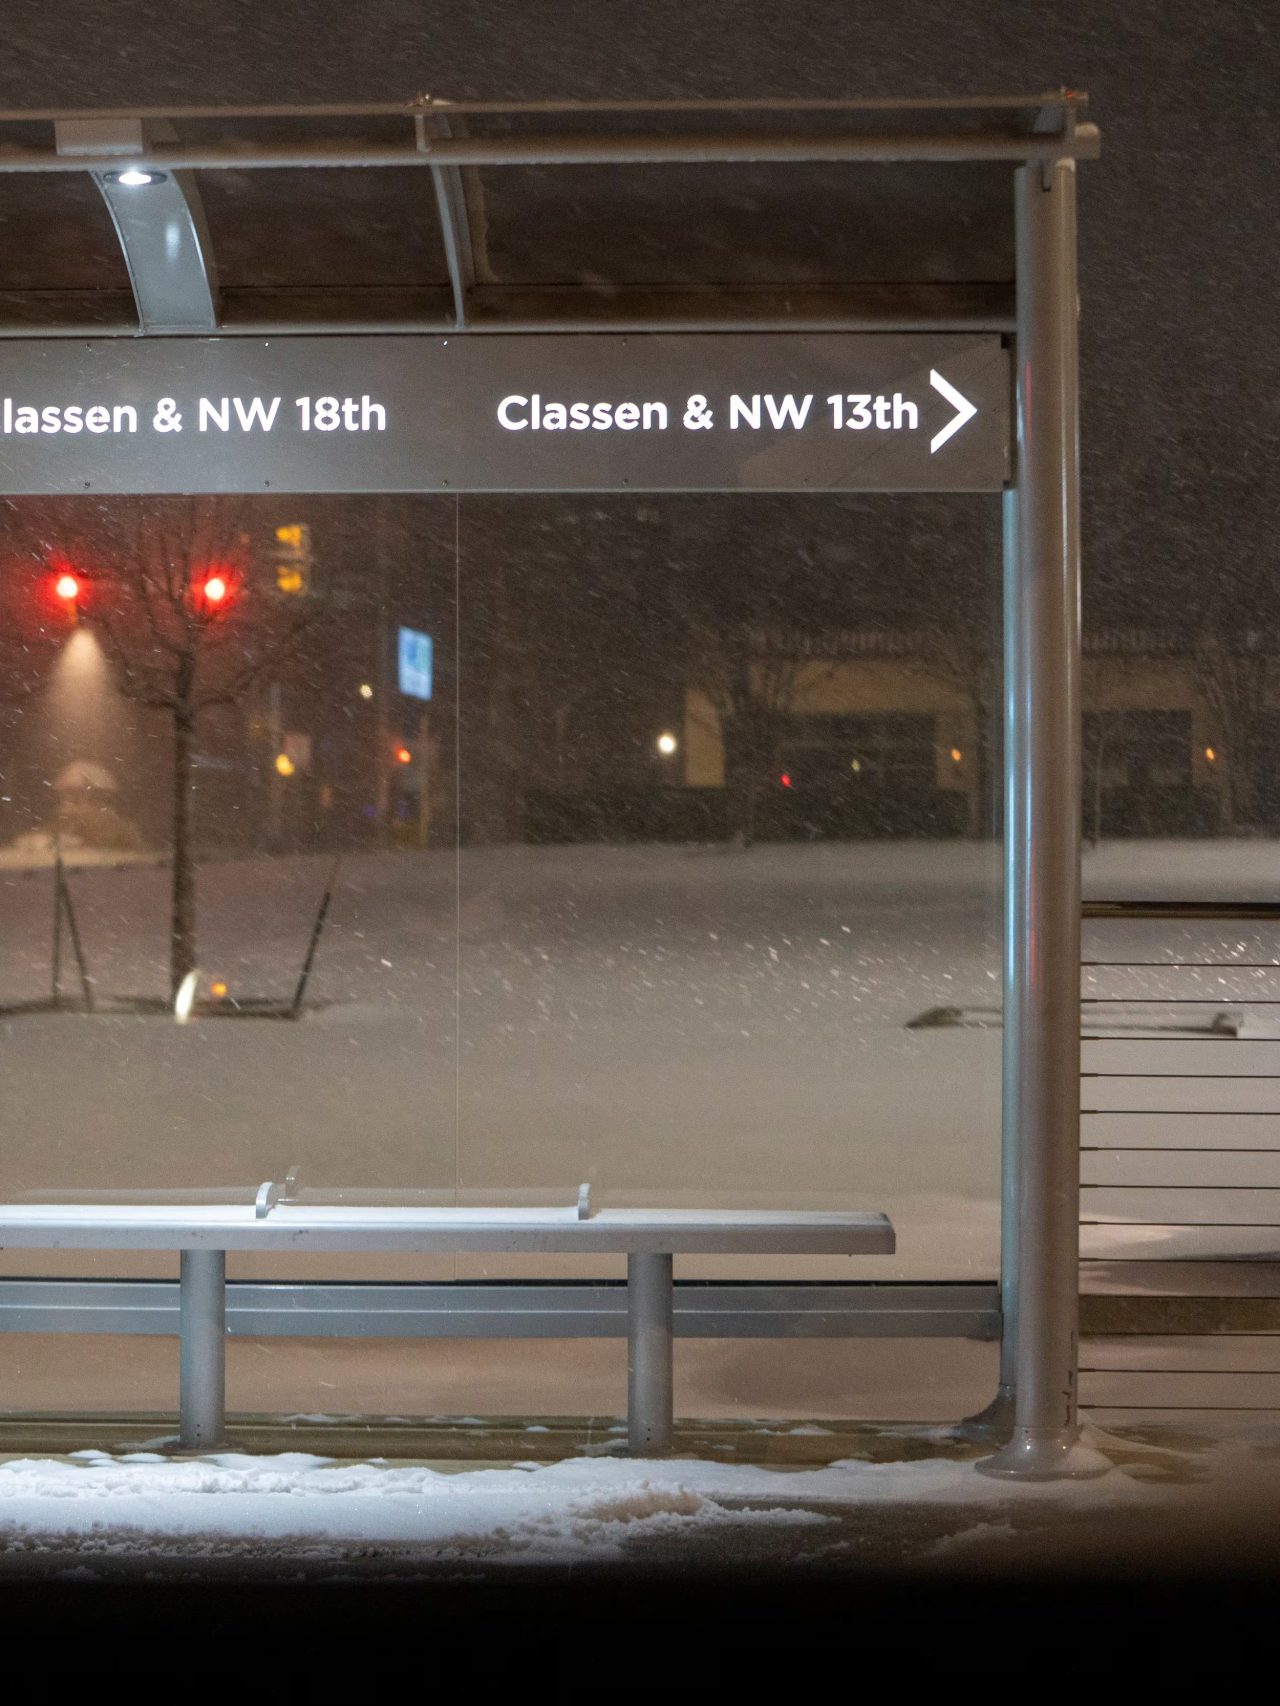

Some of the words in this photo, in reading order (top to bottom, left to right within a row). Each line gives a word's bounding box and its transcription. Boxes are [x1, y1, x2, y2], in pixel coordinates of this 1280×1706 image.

[152, 397, 183, 433] &
[198, 396, 282, 432] NW
[295, 394, 386, 432] 18th
[496, 393, 668, 431] Classen
[682, 394, 714, 430] &
[729, 394, 814, 430] NW
[826, 392, 919, 430] 13th
